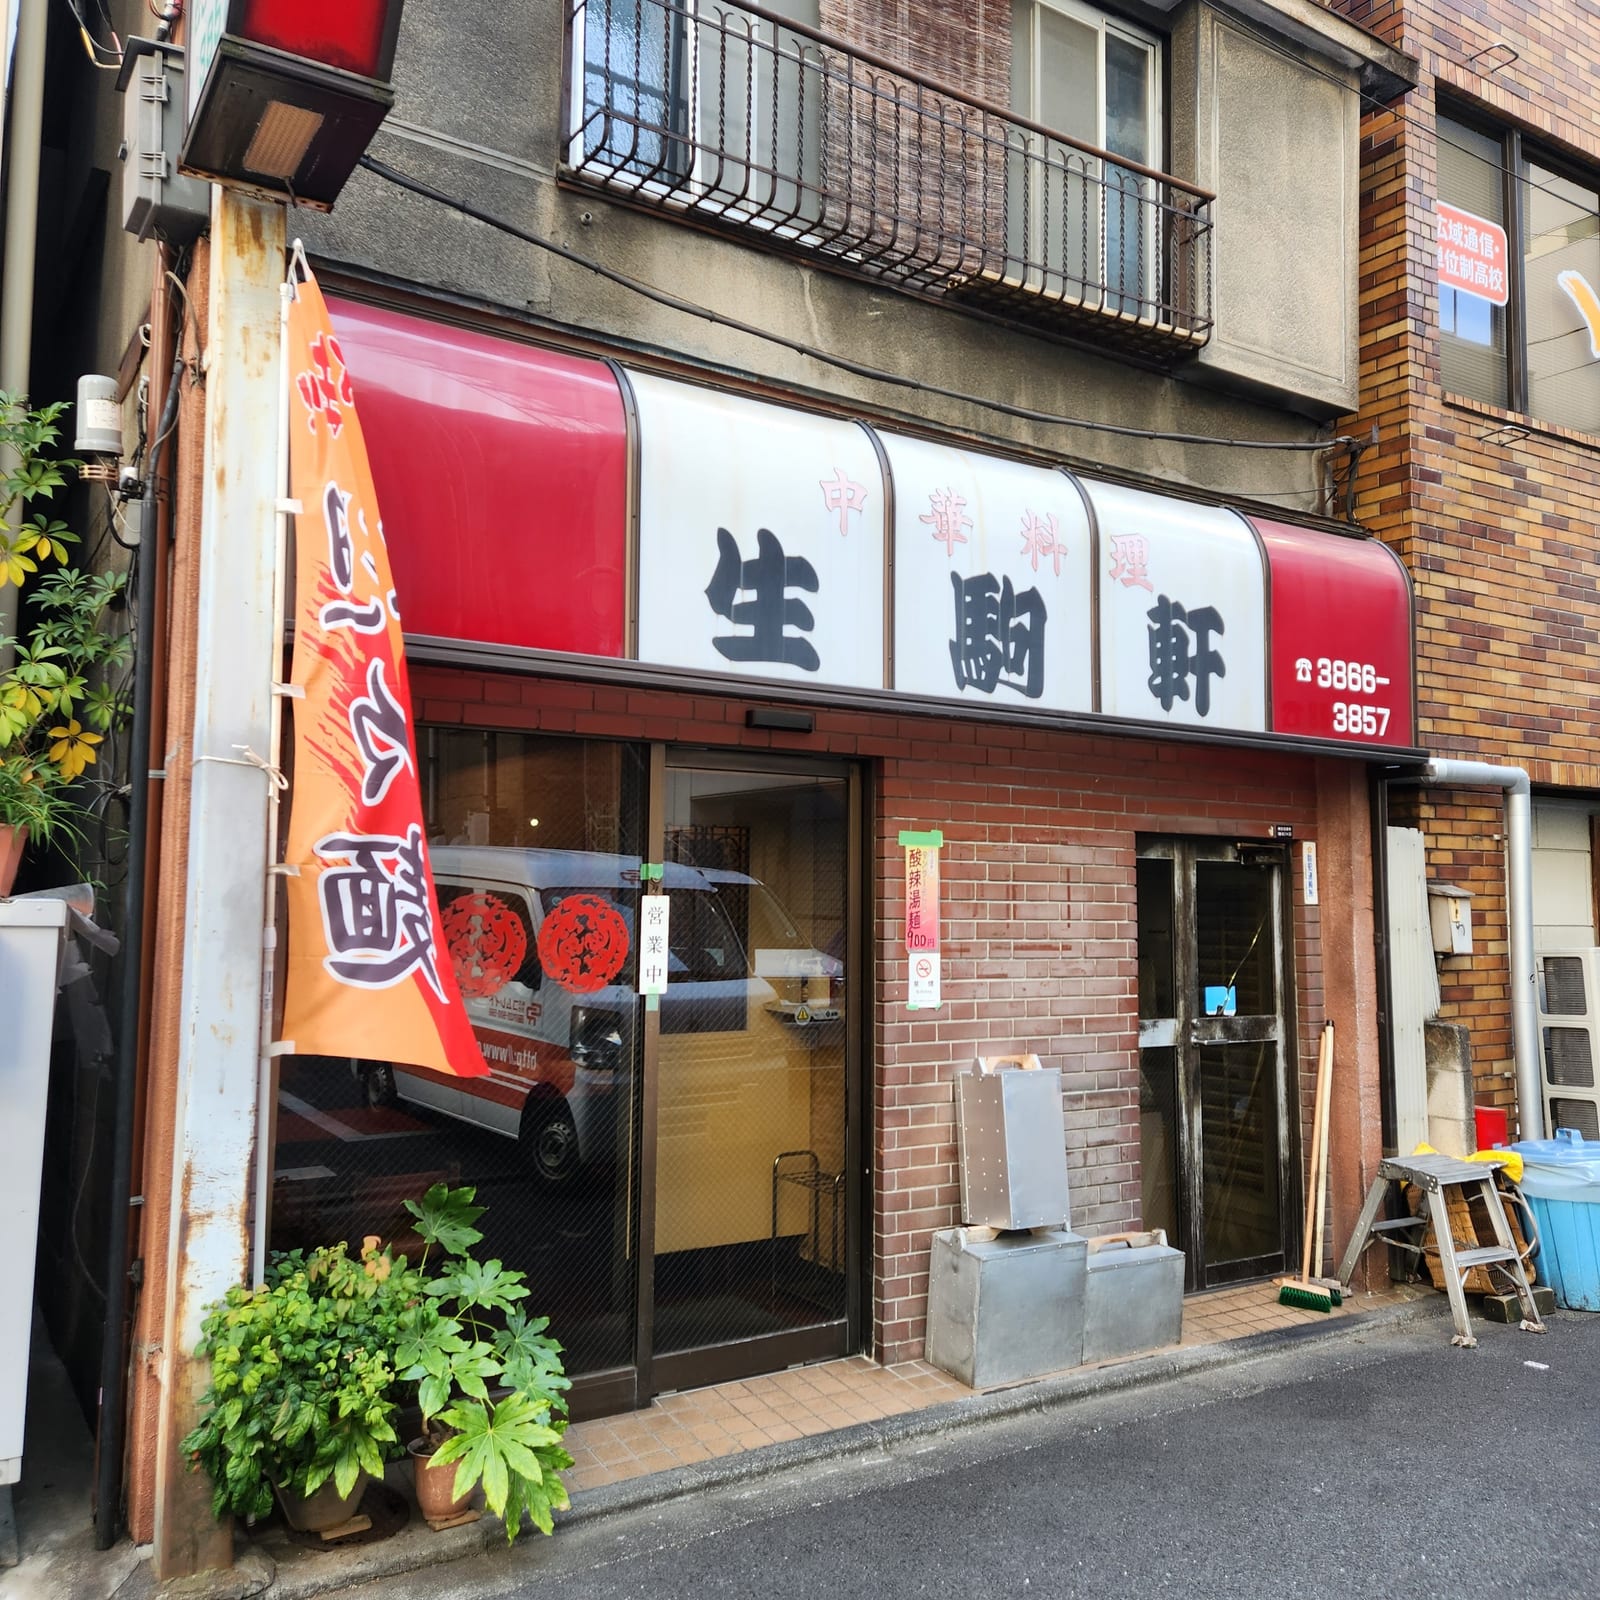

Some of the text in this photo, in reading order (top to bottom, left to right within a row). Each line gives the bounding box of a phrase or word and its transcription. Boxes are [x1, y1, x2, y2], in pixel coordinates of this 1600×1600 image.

[819, 467, 1154, 595] 中華料理
[704, 527, 1226, 718] 生駒軒
[1332, 702, 1391, 737] 3857
[647, 906, 664, 984] 営業中
